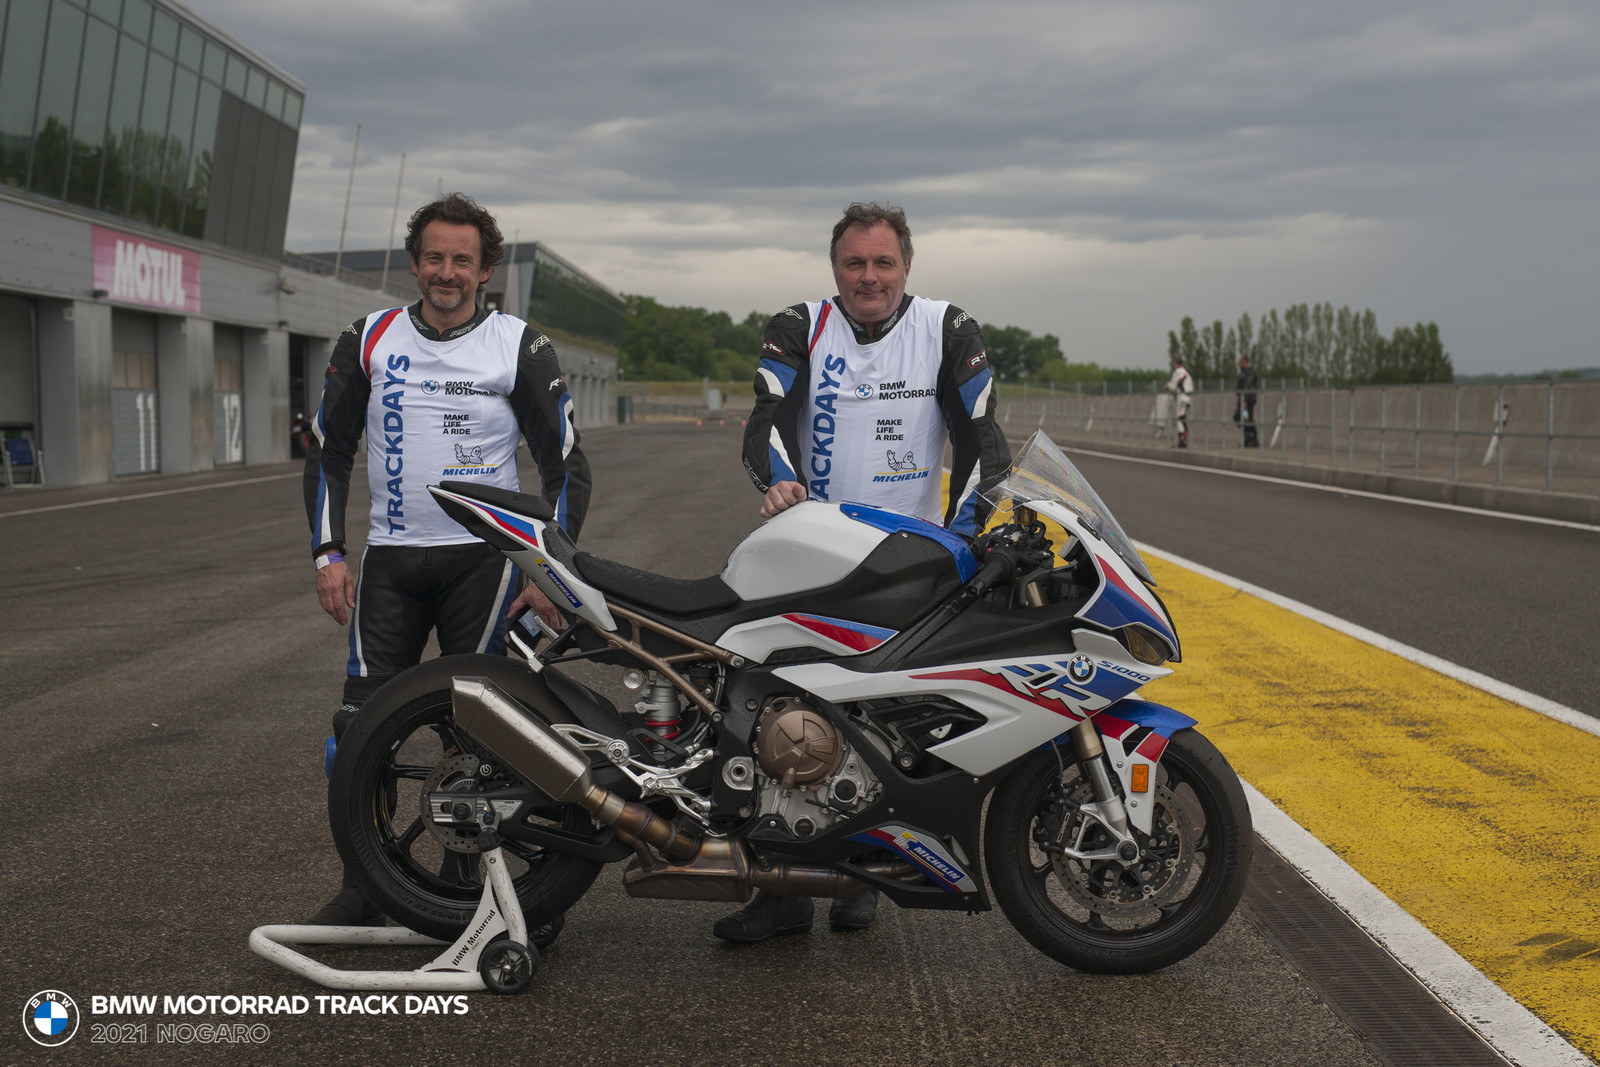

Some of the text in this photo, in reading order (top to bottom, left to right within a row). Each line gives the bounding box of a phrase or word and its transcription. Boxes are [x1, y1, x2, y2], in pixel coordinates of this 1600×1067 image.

[113, 239, 186, 307] MOTUL
[878, 388, 936, 400] MOTORRAD
[879, 381, 906, 390] BMW
[136, 392, 157, 472] 11
[223, 394, 242, 463] 12
[383, 353, 410, 535] TRACKDAYS
[809, 353, 846, 502] ACKDAYS
[442, 467, 498, 476] MICHELIN
[872, 470, 930, 483] MICHELIN
[1097, 660, 1151, 682] S1000
[913, 846, 961, 880] MICHELIN
[451, 909, 496, 967] BMW Motorrad
